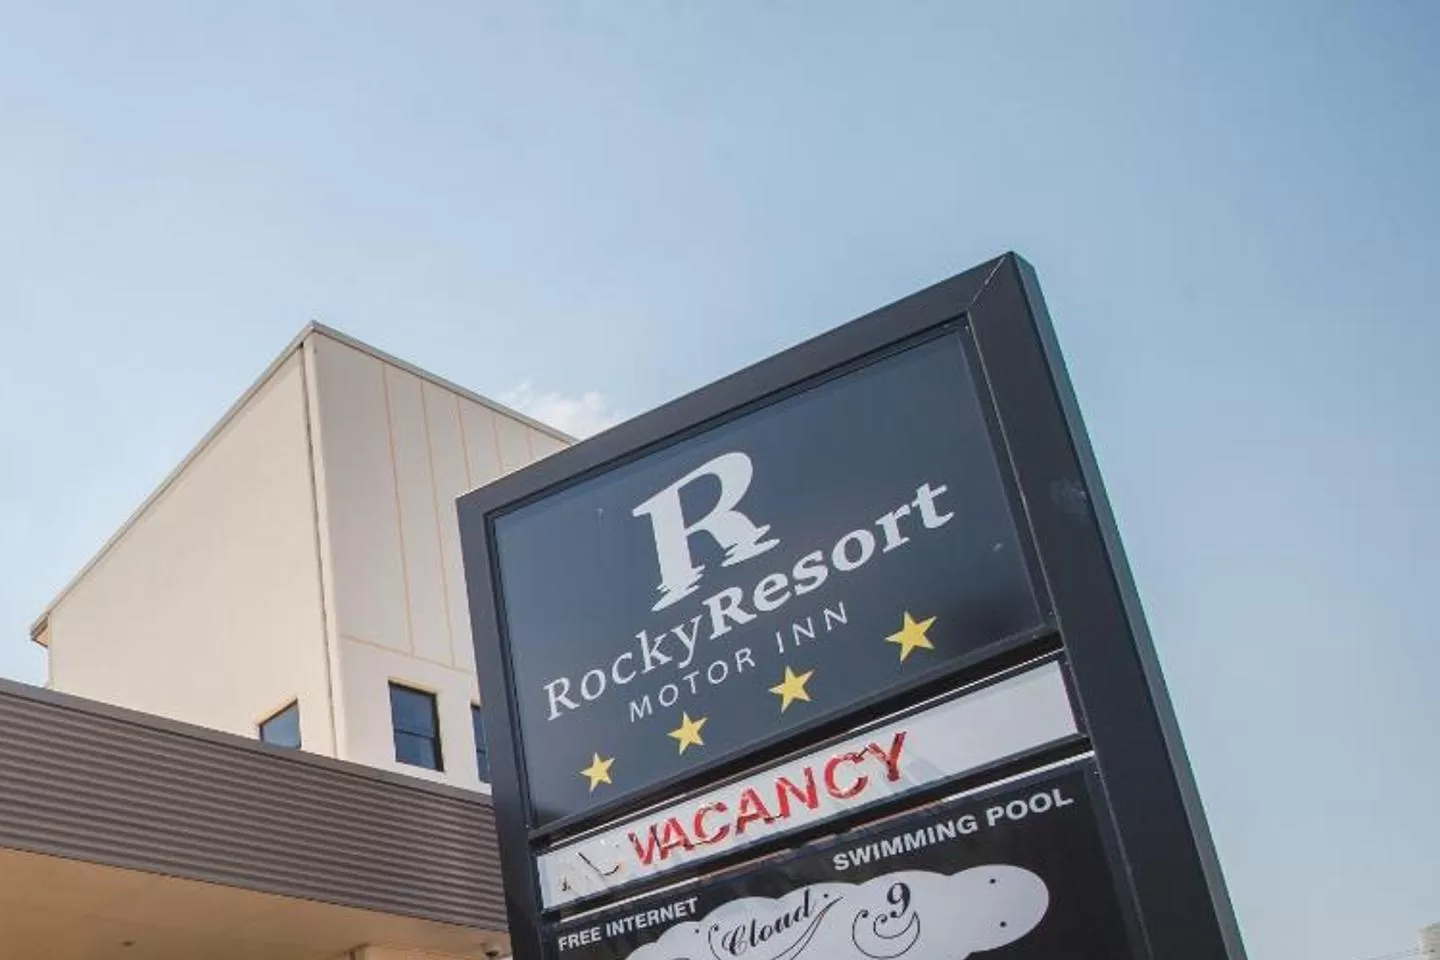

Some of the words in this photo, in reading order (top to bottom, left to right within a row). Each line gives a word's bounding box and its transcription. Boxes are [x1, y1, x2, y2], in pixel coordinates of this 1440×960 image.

[628, 647, 755, 723] MOTOR
[775, 601, 849, 654] INN
[627, 731, 907, 866] VACANCY
[832, 814, 978, 871] SWIMMING
[986, 788, 1074, 827] POOL
[558, 926, 602, 951] FREE
[606, 897, 698, 938] INTERNET
[721, 888, 811, 956] Cloud
[886, 882, 911, 919] 9
